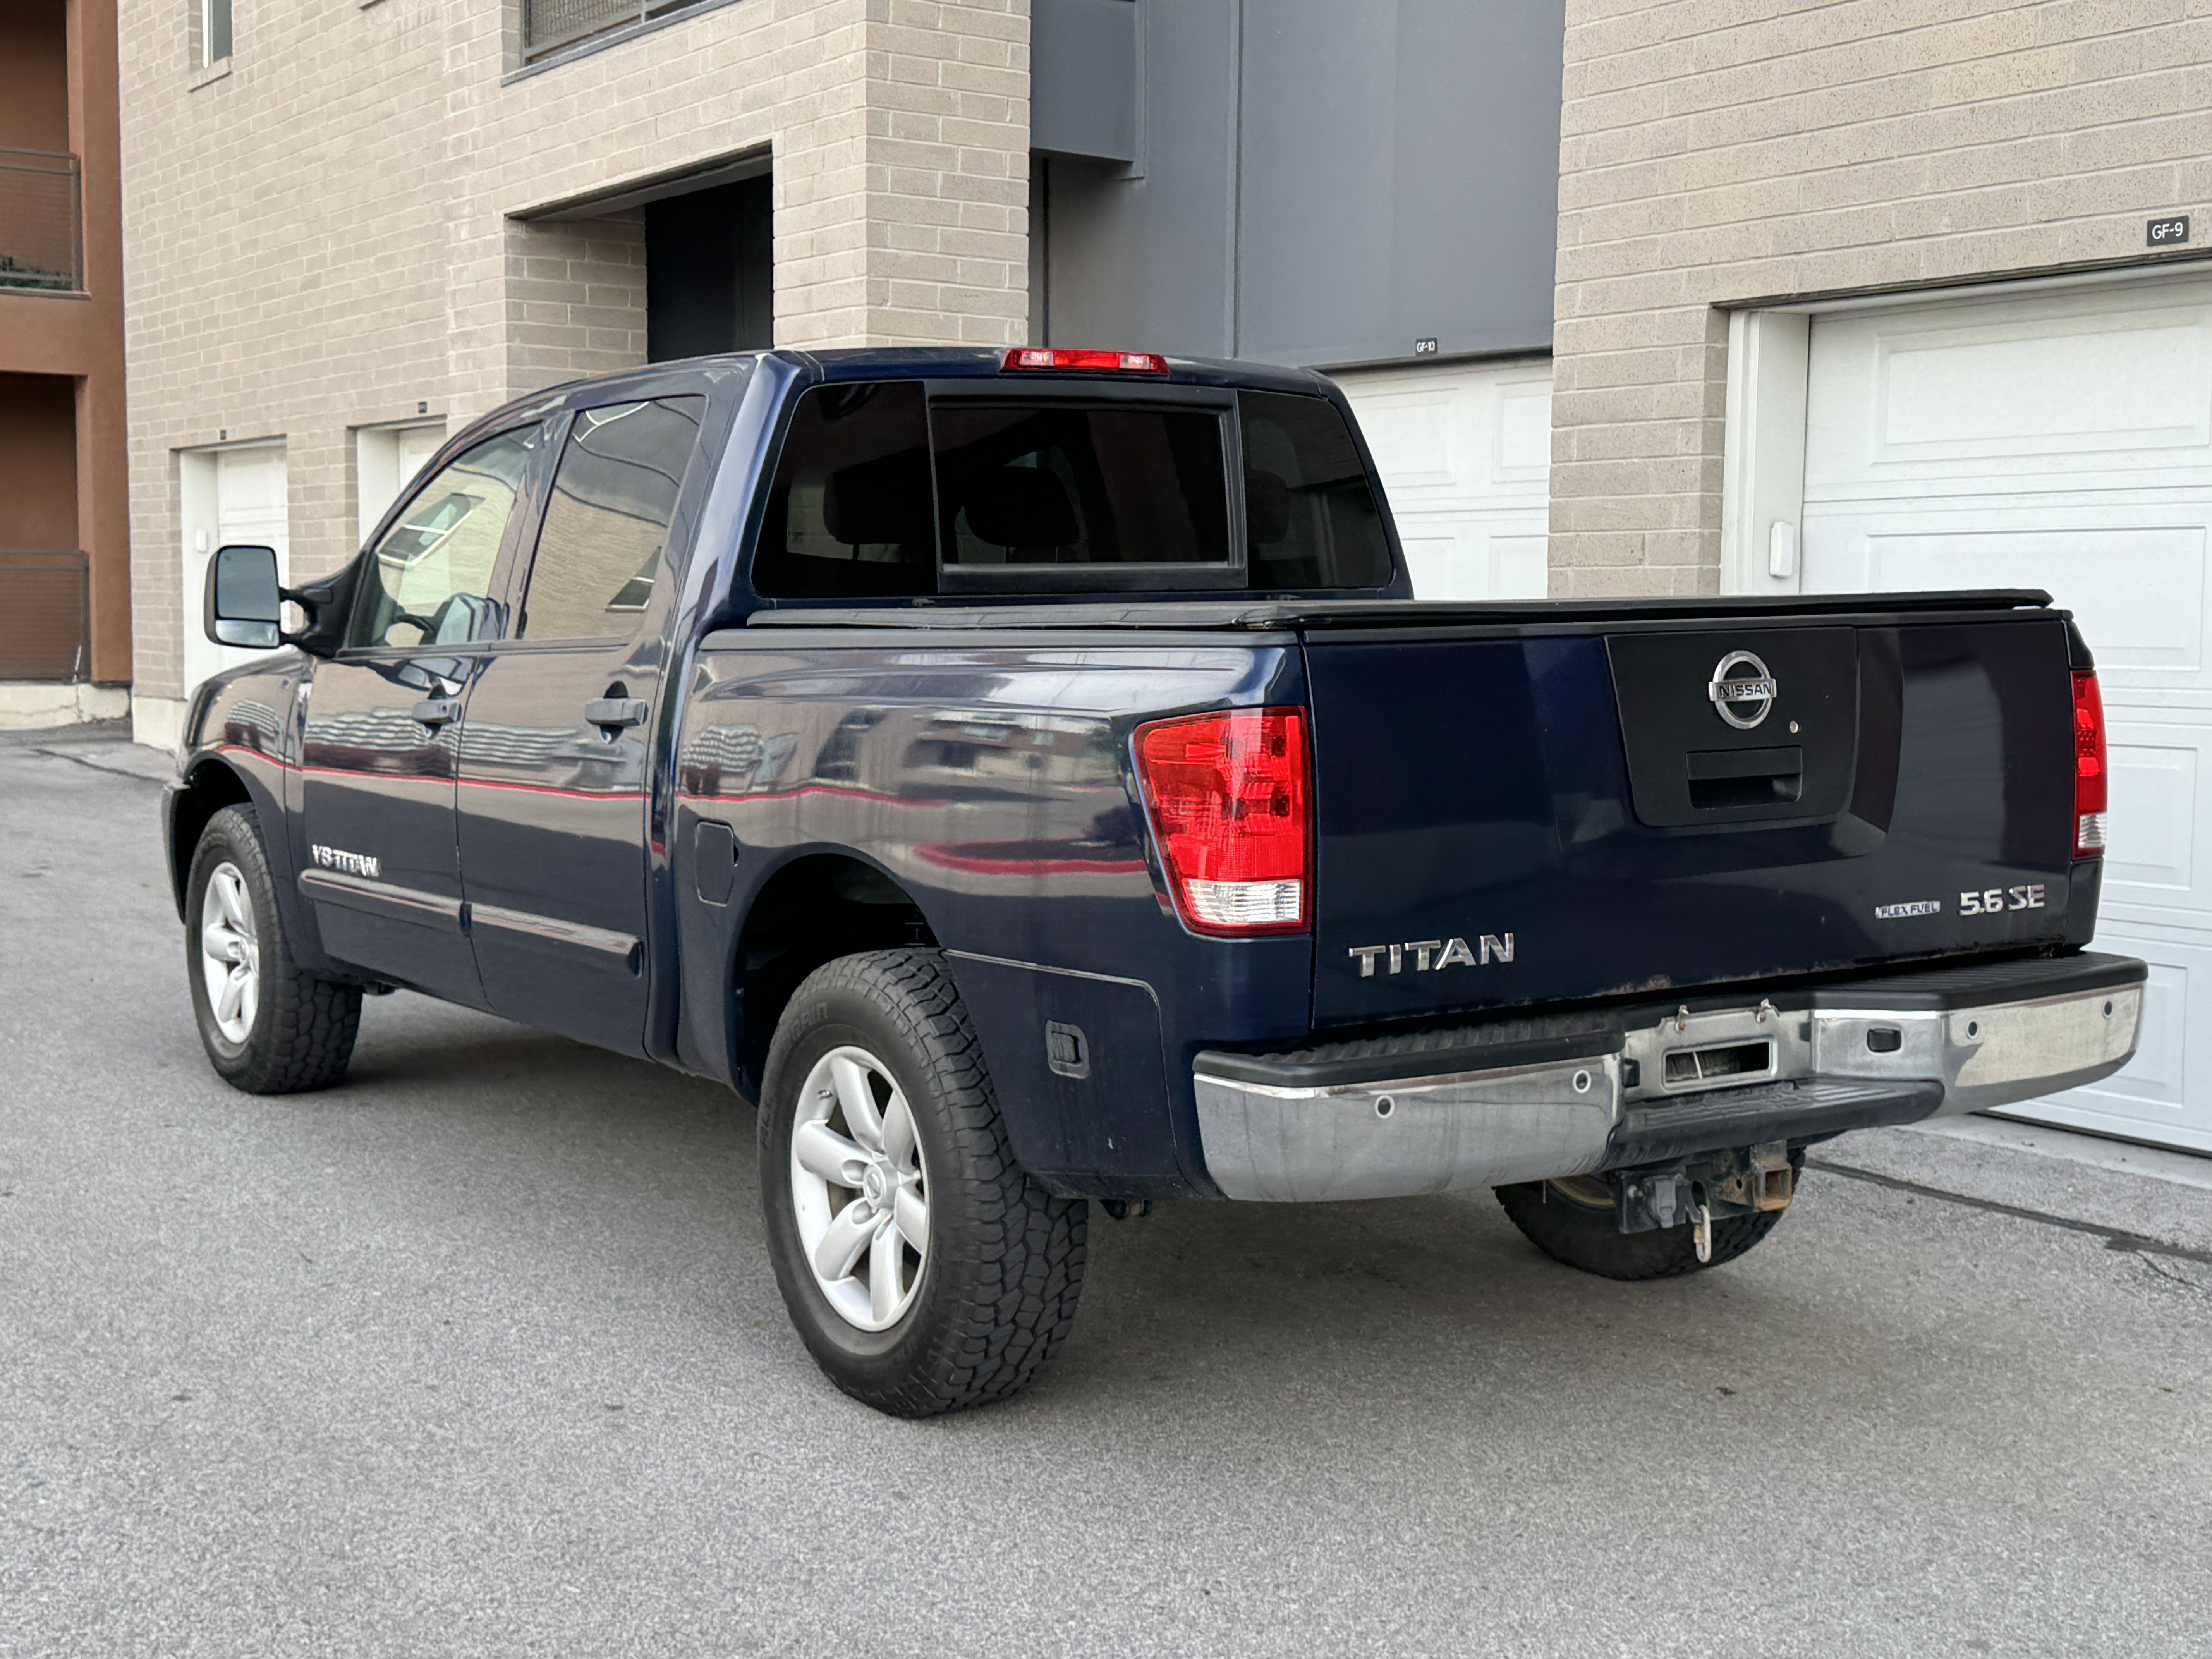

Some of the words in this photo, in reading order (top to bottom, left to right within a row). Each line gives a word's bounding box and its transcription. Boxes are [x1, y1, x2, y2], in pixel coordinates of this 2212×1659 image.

[2152, 222, 2183, 240] GF-9
[1417, 340, 1436, 352] GF-10
[1719, 683, 1772, 697] NISSAN
[1881, 906, 1908, 917] FLEX
[1911, 903, 1937, 914] FUEL
[1348, 933, 1514, 978] TITAN
